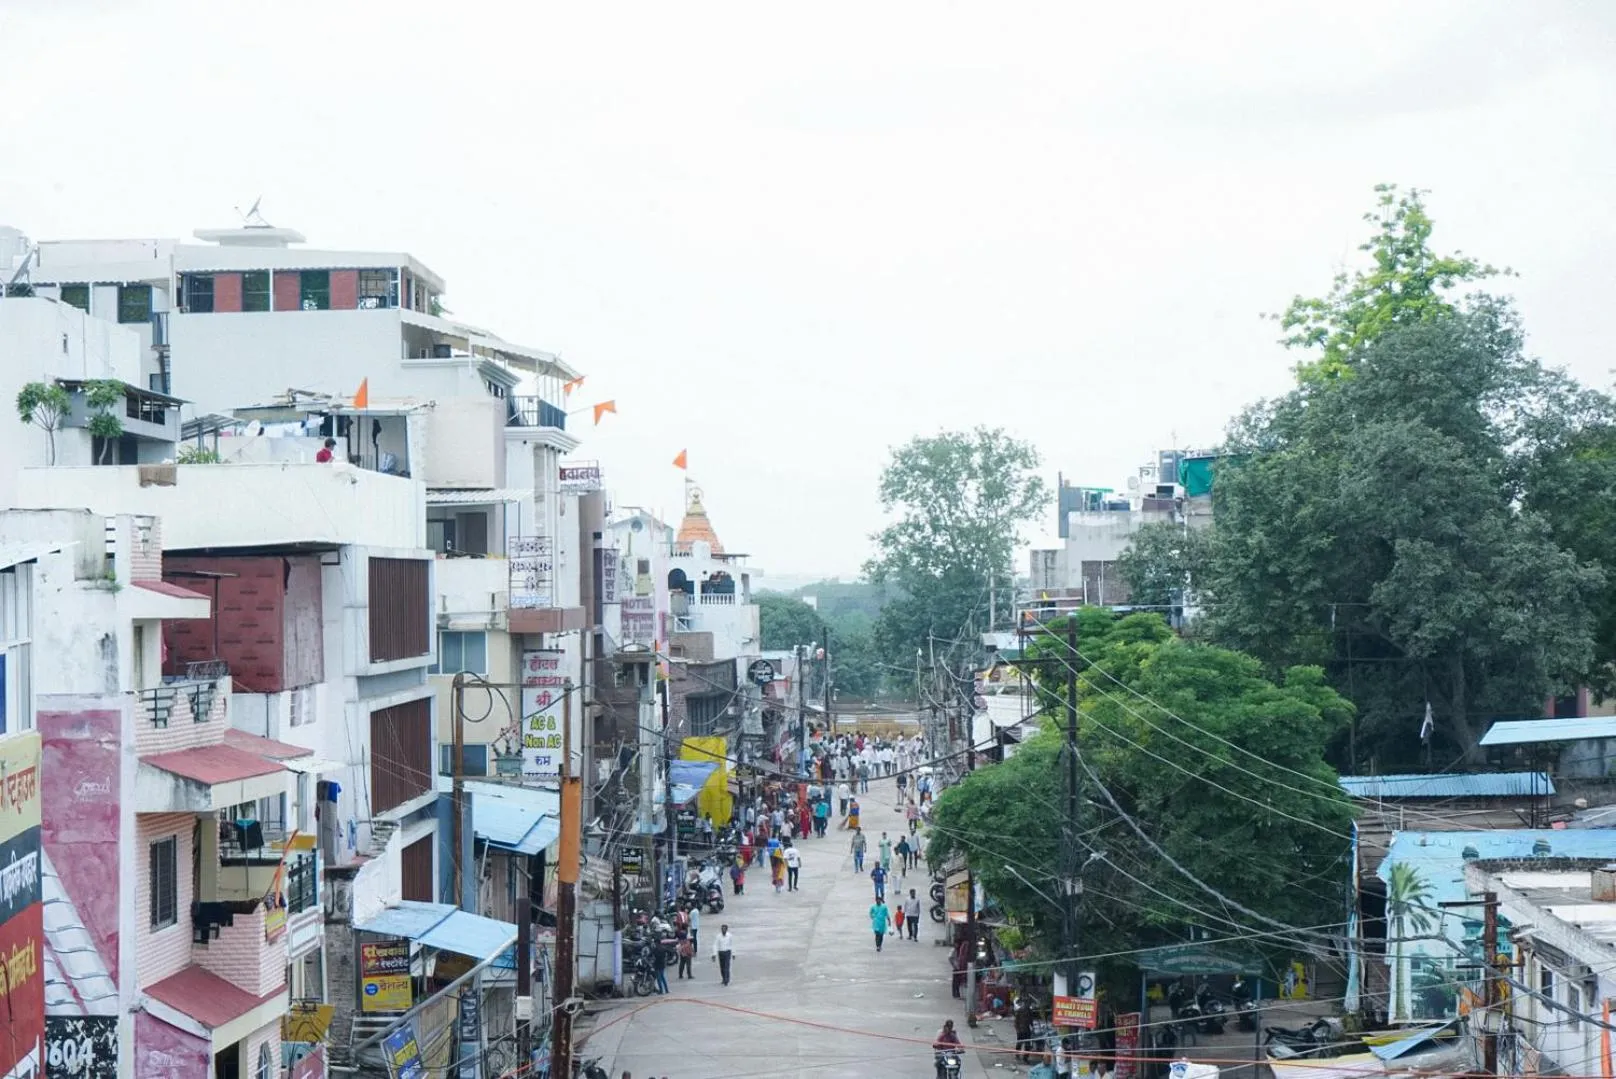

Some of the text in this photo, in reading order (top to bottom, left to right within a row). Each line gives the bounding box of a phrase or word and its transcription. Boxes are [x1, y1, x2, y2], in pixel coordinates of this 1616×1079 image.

[621, 598, 653, 609] HOTEL
[530, 715, 545, 731] AC
[525, 733, 562, 749] Non AC
